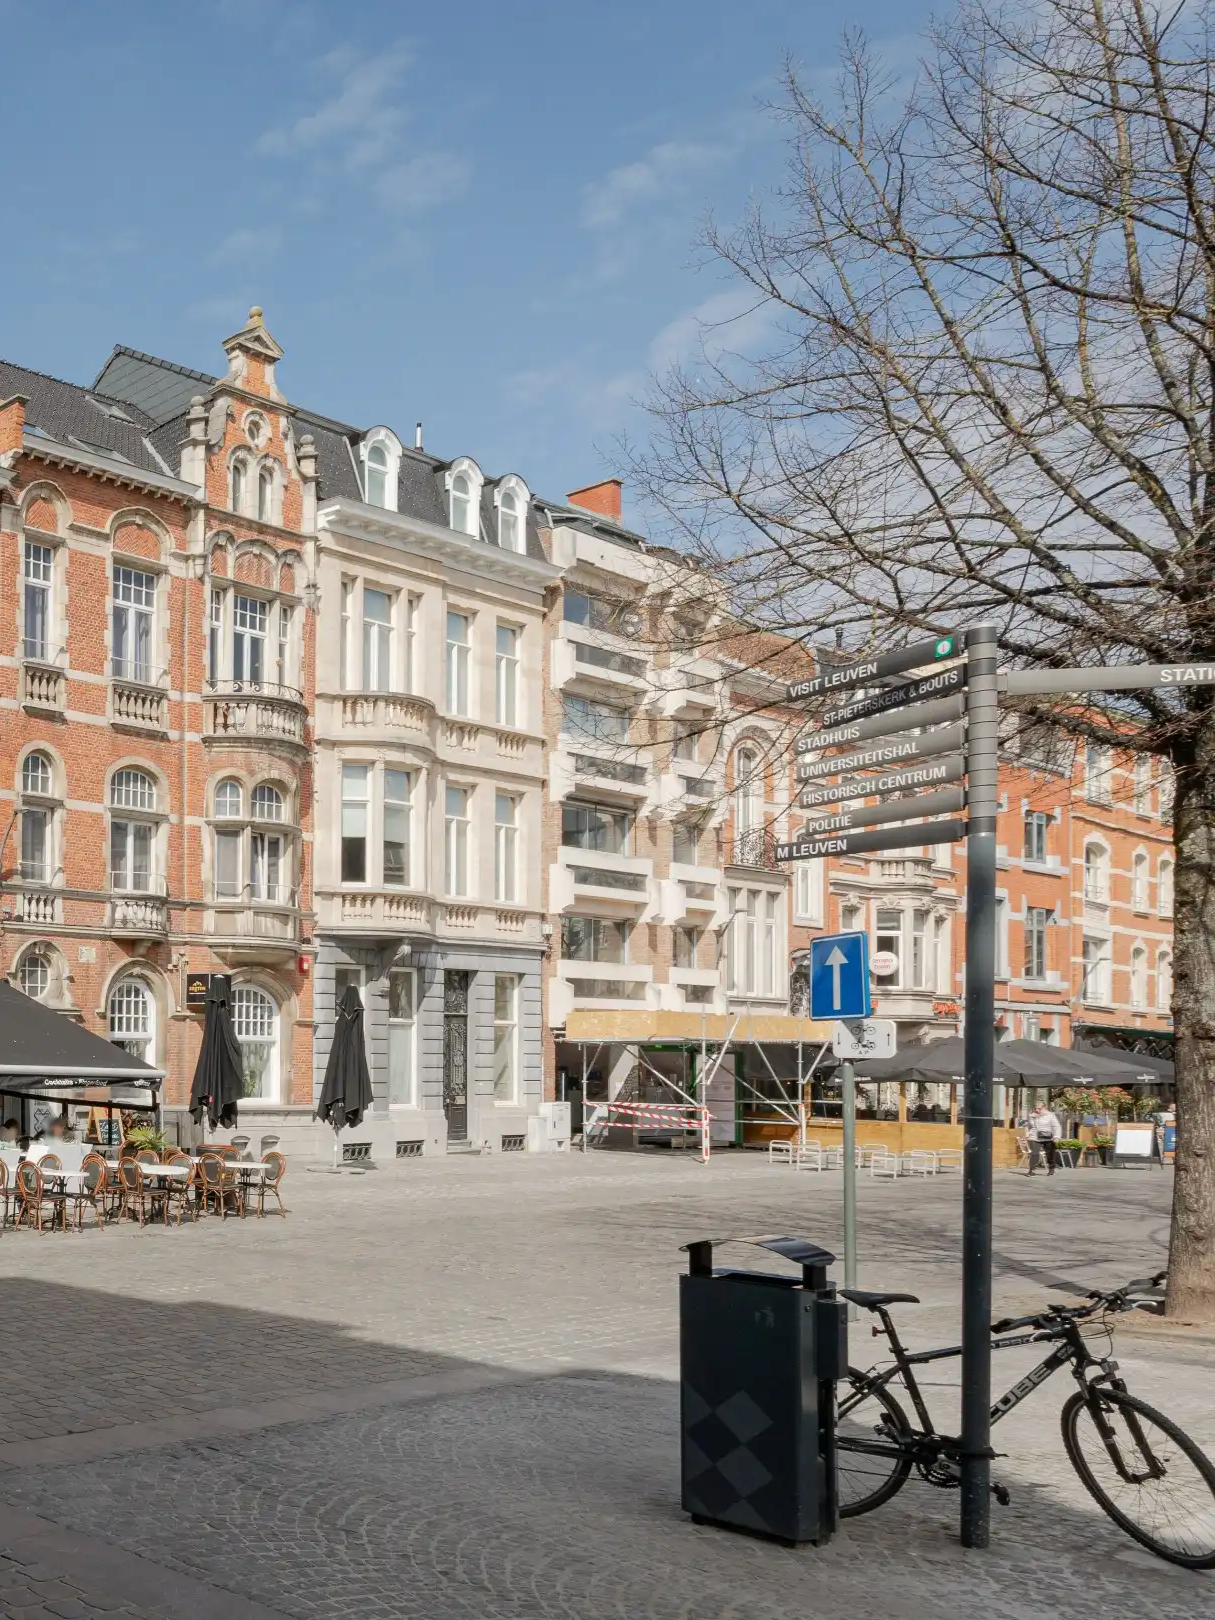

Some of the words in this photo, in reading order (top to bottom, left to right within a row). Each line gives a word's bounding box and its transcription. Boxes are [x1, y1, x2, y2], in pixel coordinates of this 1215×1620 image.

[789, 678, 822, 698] VISIT
[824, 661, 878, 688] LEUVEN
[823, 688, 907, 726] ST-PIETERSKERK
[908, 685, 917, 697] &
[918, 670, 959, 694] BOUTS
[797, 726, 860, 751] STADHUIS
[800, 742, 920, 778] UNIVERSITEITSHAL
[802, 779, 876, 806] HISTORISCH
[878, 765, 947, 790] CENTRUM
[809, 814, 852, 833] POLITIE
[777, 847, 789, 859] M
[792, 838, 847, 857] LEUVEN
